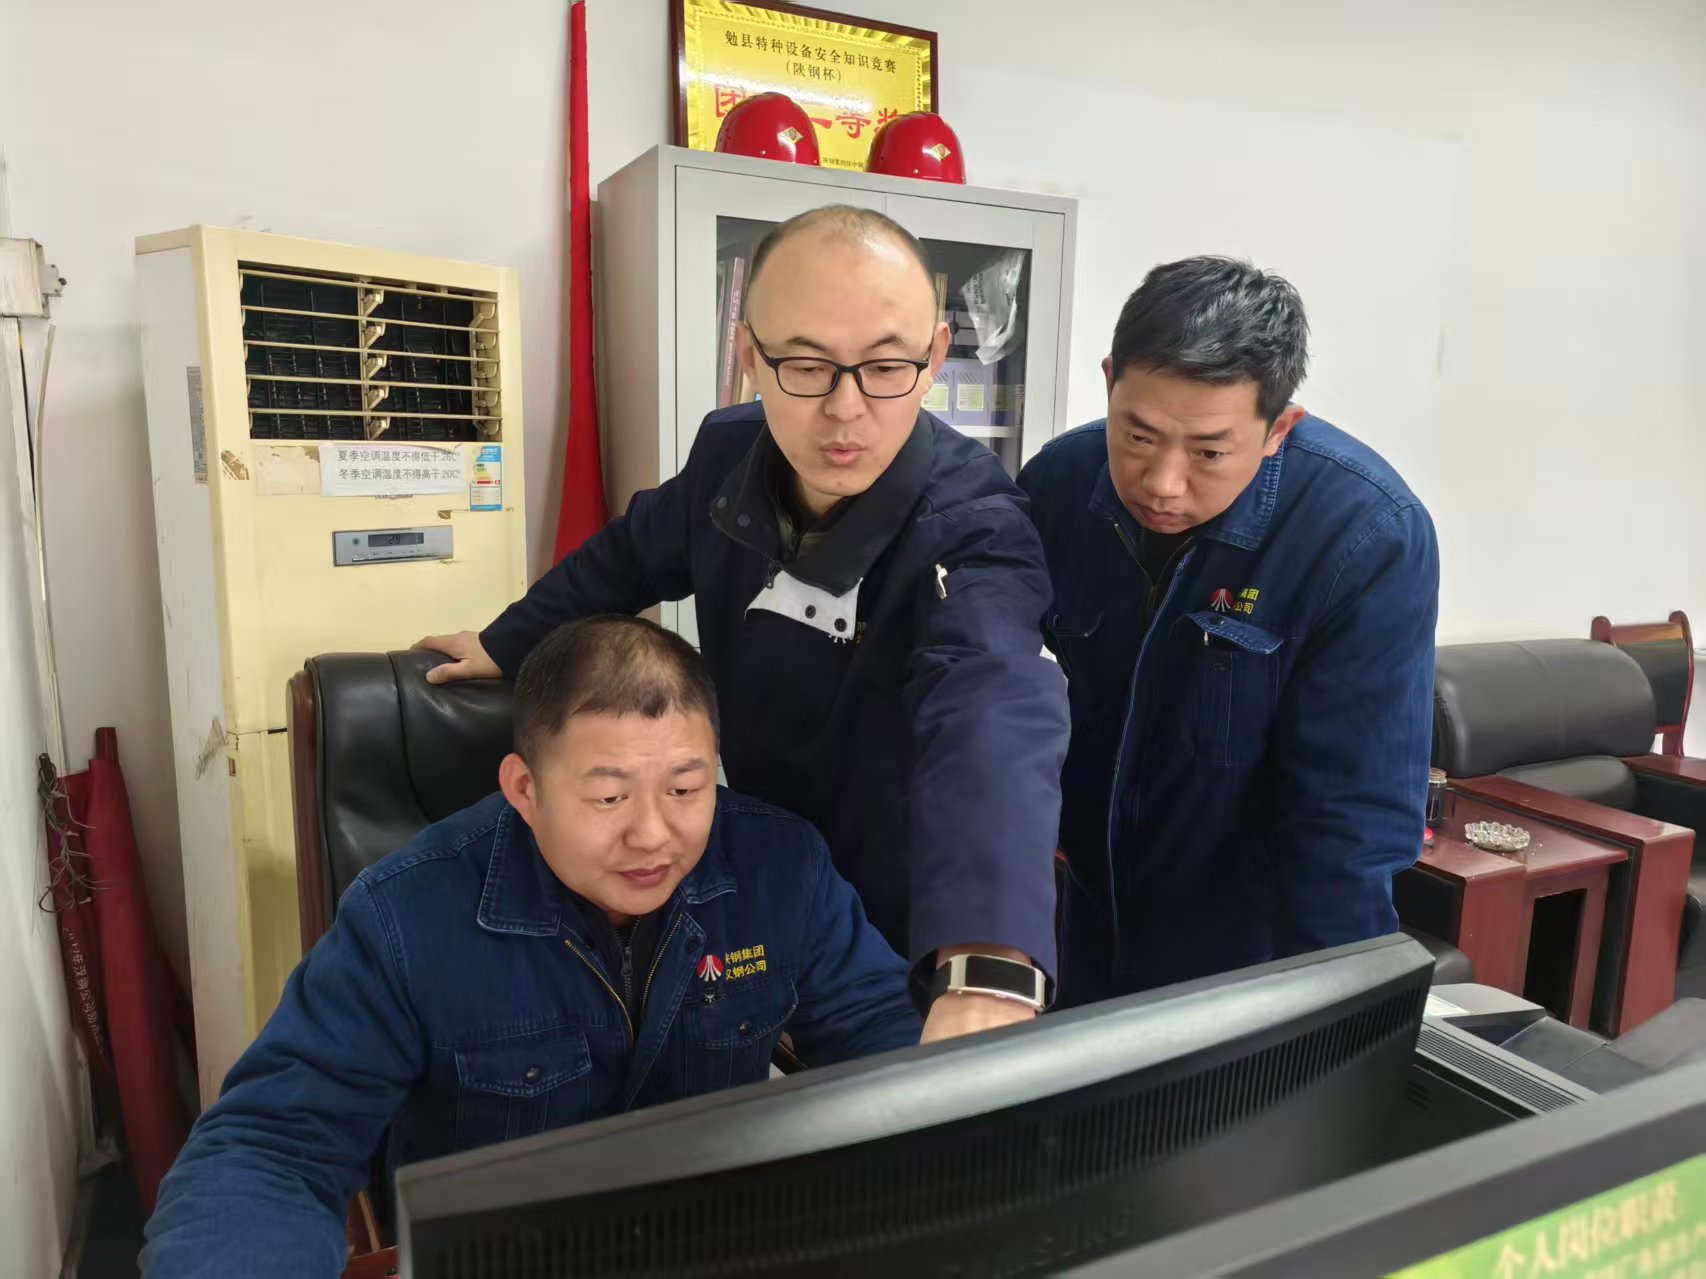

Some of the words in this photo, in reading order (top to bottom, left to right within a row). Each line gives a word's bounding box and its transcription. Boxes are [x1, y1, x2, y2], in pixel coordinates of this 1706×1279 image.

[725, 30, 896, 74] 勉县特种设备安全知识竞赛
